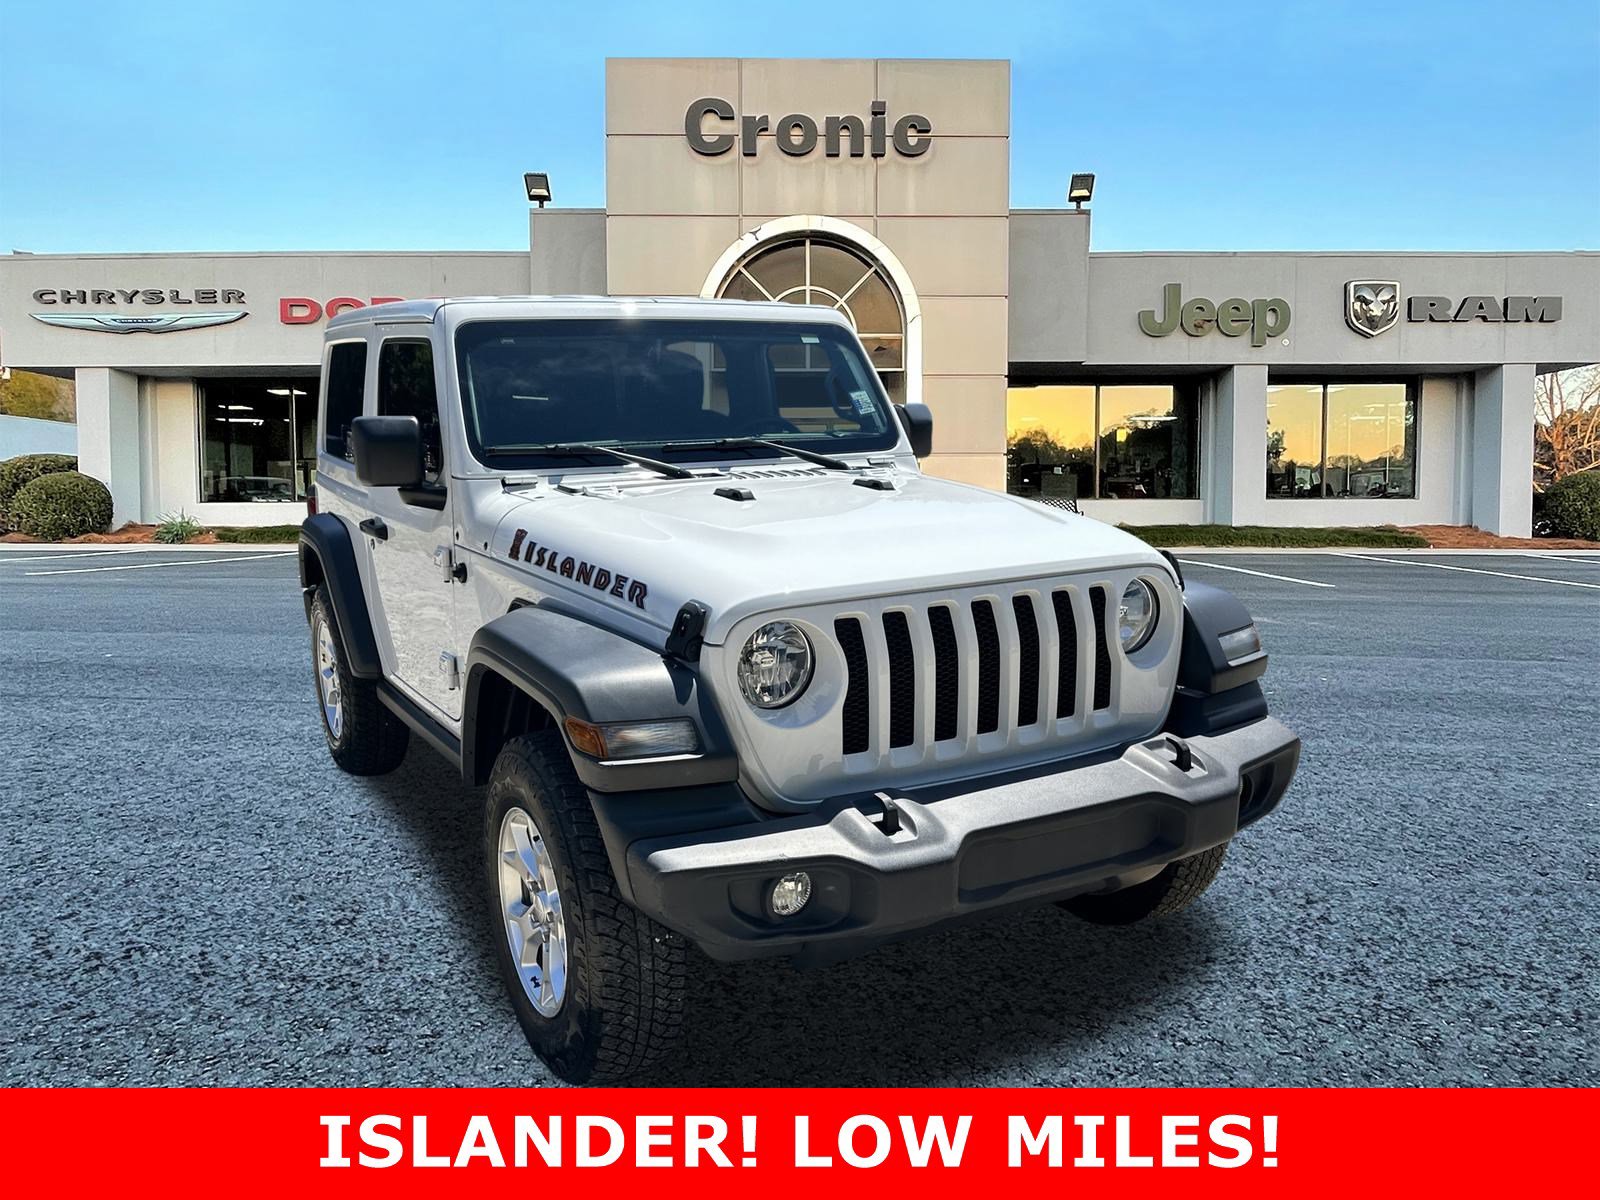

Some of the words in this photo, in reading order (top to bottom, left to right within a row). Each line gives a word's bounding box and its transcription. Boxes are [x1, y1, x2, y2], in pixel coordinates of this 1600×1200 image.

[685, 97, 932, 158] Cronic
[32, 289, 247, 304] CHRYSLER
[1138, 282, 1291, 347] Jeep
[1408, 295, 1563, 323] RAM
[524, 540, 648, 609] ISLANDER
